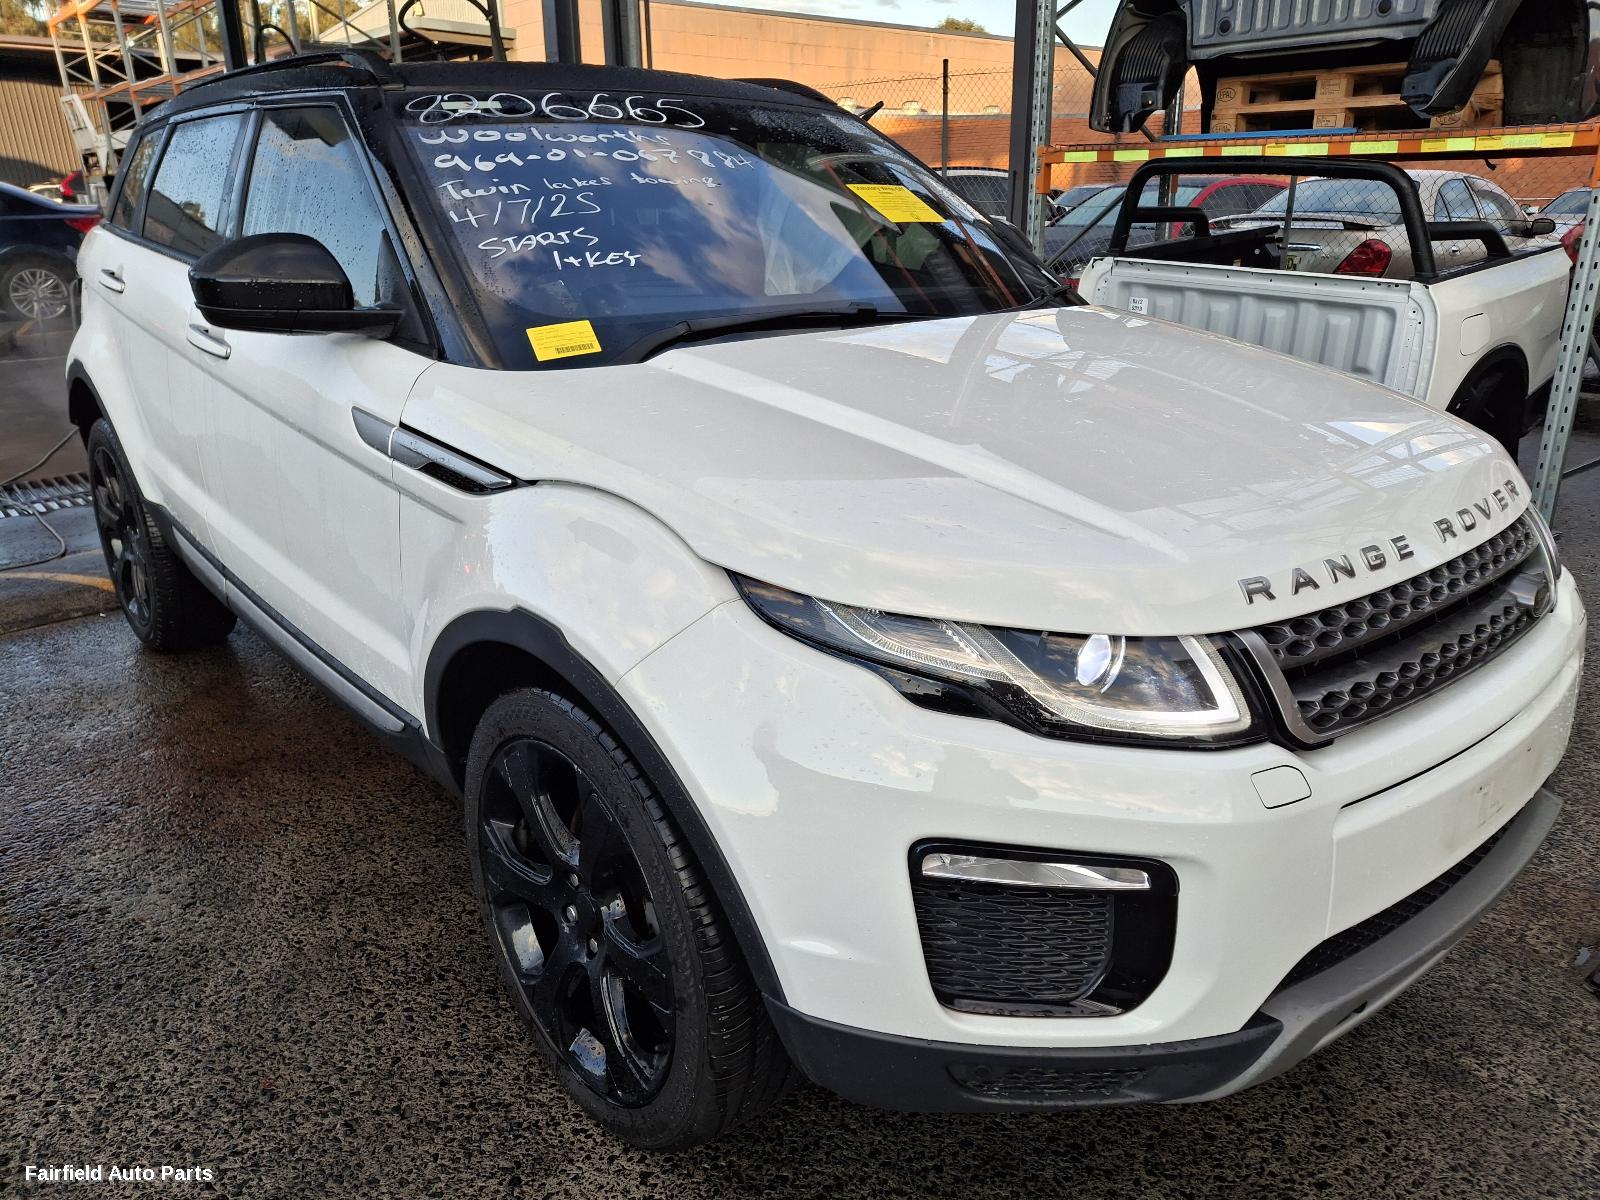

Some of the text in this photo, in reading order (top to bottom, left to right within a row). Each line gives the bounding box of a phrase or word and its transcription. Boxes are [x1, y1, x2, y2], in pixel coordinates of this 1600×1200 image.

[439, 178, 532, 201] Twin
[449, 191, 602, 229] 4/7/25
[478, 226, 600, 260] STARTS
[1237, 479, 1522, 606] RANGE ROVER
